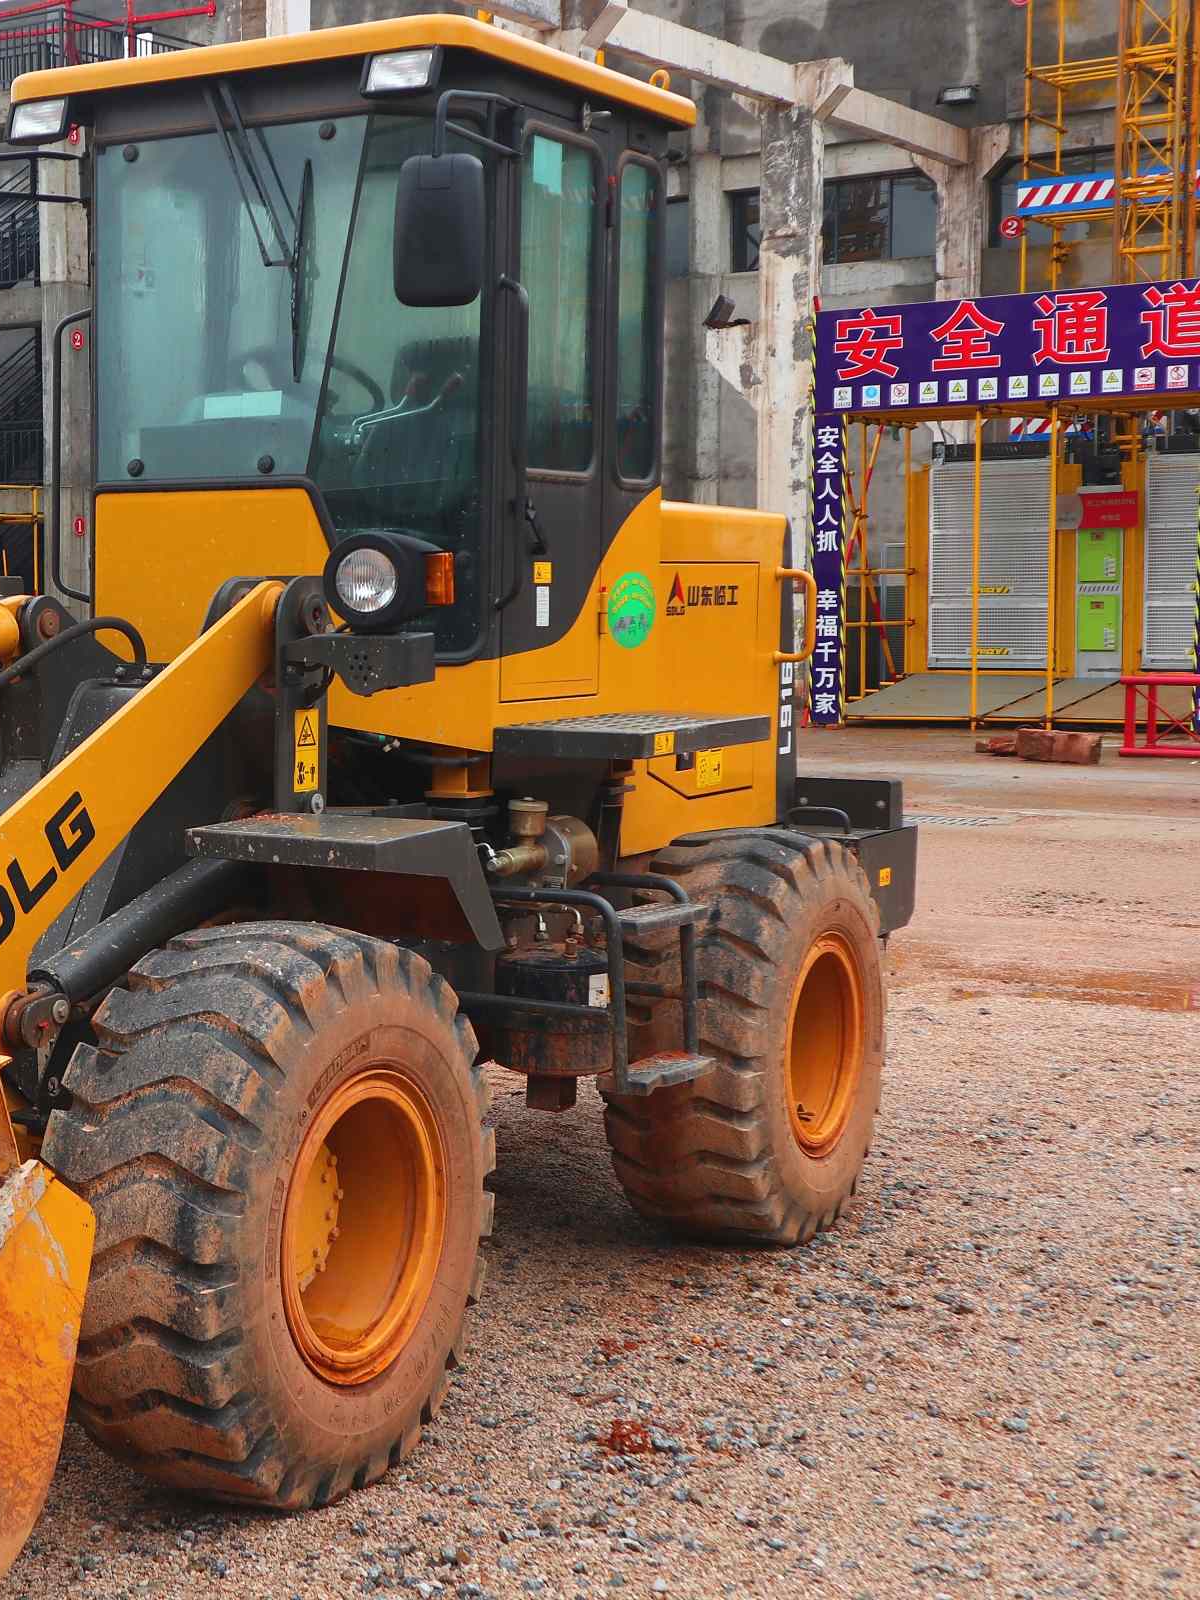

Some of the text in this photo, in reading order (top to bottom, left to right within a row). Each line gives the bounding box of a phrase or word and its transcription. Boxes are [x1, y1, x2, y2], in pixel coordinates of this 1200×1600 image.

[834, 280, 1200, 381] 安全通道
[687, 585, 739, 607] 山东临工
[815, 425, 840, 715] 安全人人抓 幸福千万家
[665, 605, 686, 616] SDLG
